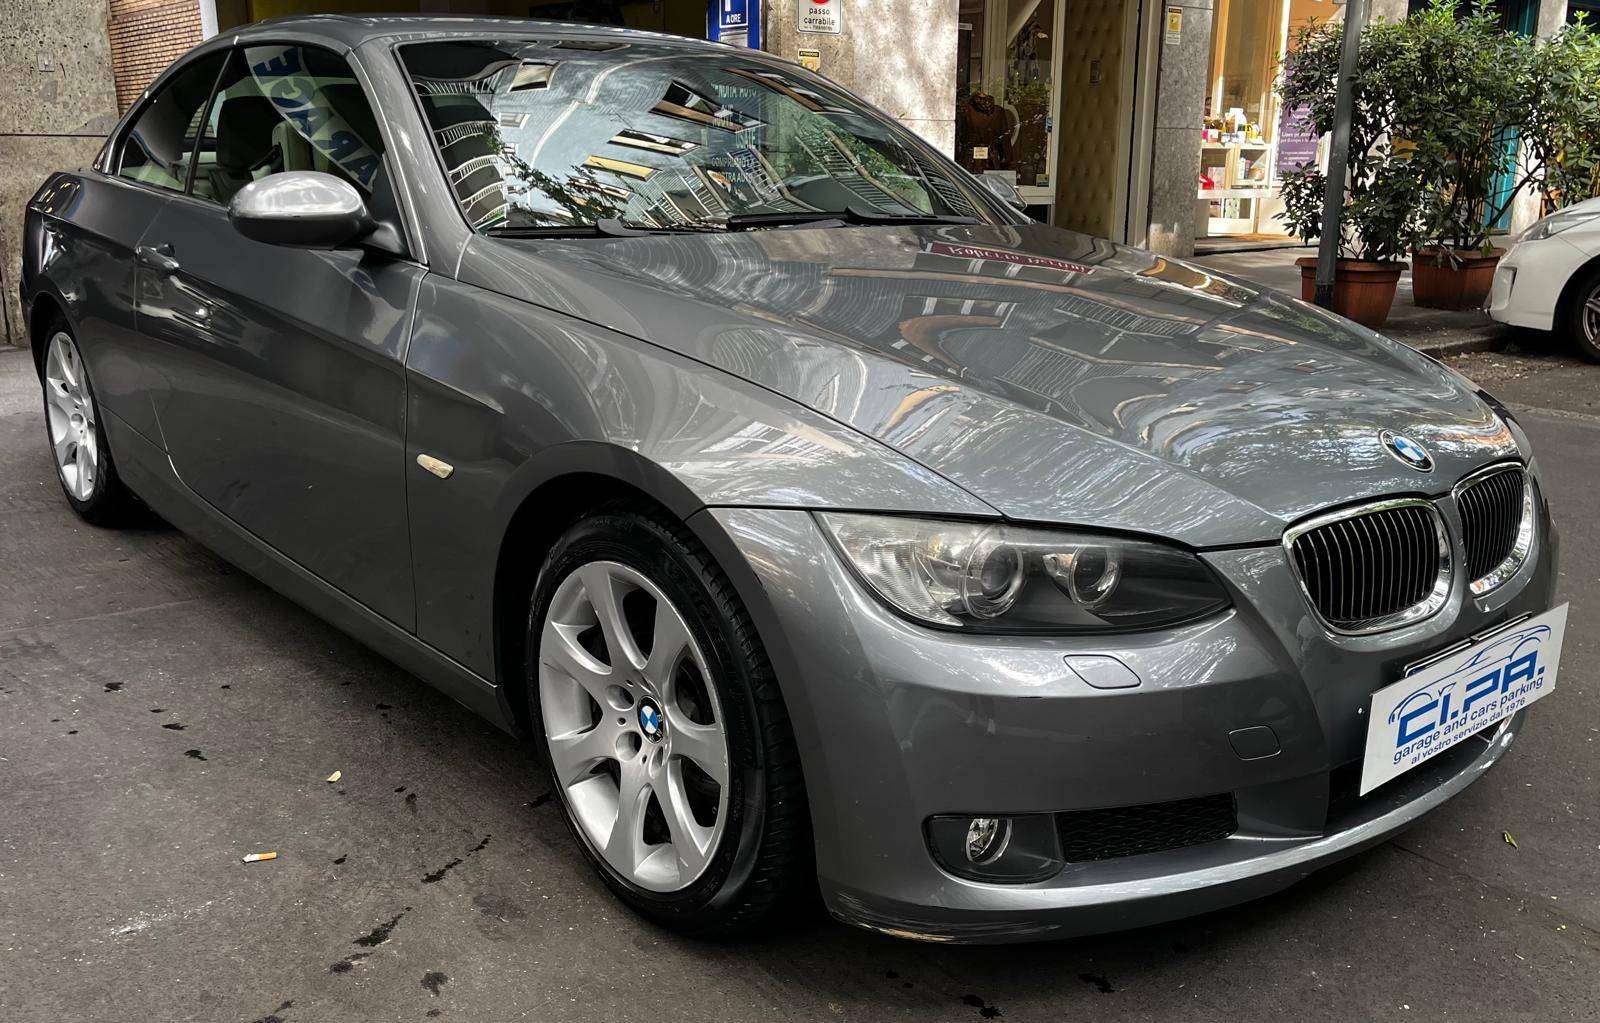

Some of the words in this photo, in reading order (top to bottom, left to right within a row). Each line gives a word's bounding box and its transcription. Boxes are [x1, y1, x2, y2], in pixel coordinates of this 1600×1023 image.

[808, 7, 830, 16] passo
[731, 13, 741, 24] ORE
[803, 16, 836, 26] carrabile
[1393, 728, 1441, 765] garage
[1444, 714, 1467, 736] and
[1470, 700, 1497, 720] cars
[1500, 676, 1544, 708] parking
[1411, 754, 1421, 765] al
[1422, 738, 1451, 759] vostro
[1453, 718, 1488, 743] servizio
[1489, 709, 1503, 723] dal
[1505, 697, 1526, 713] 1976
